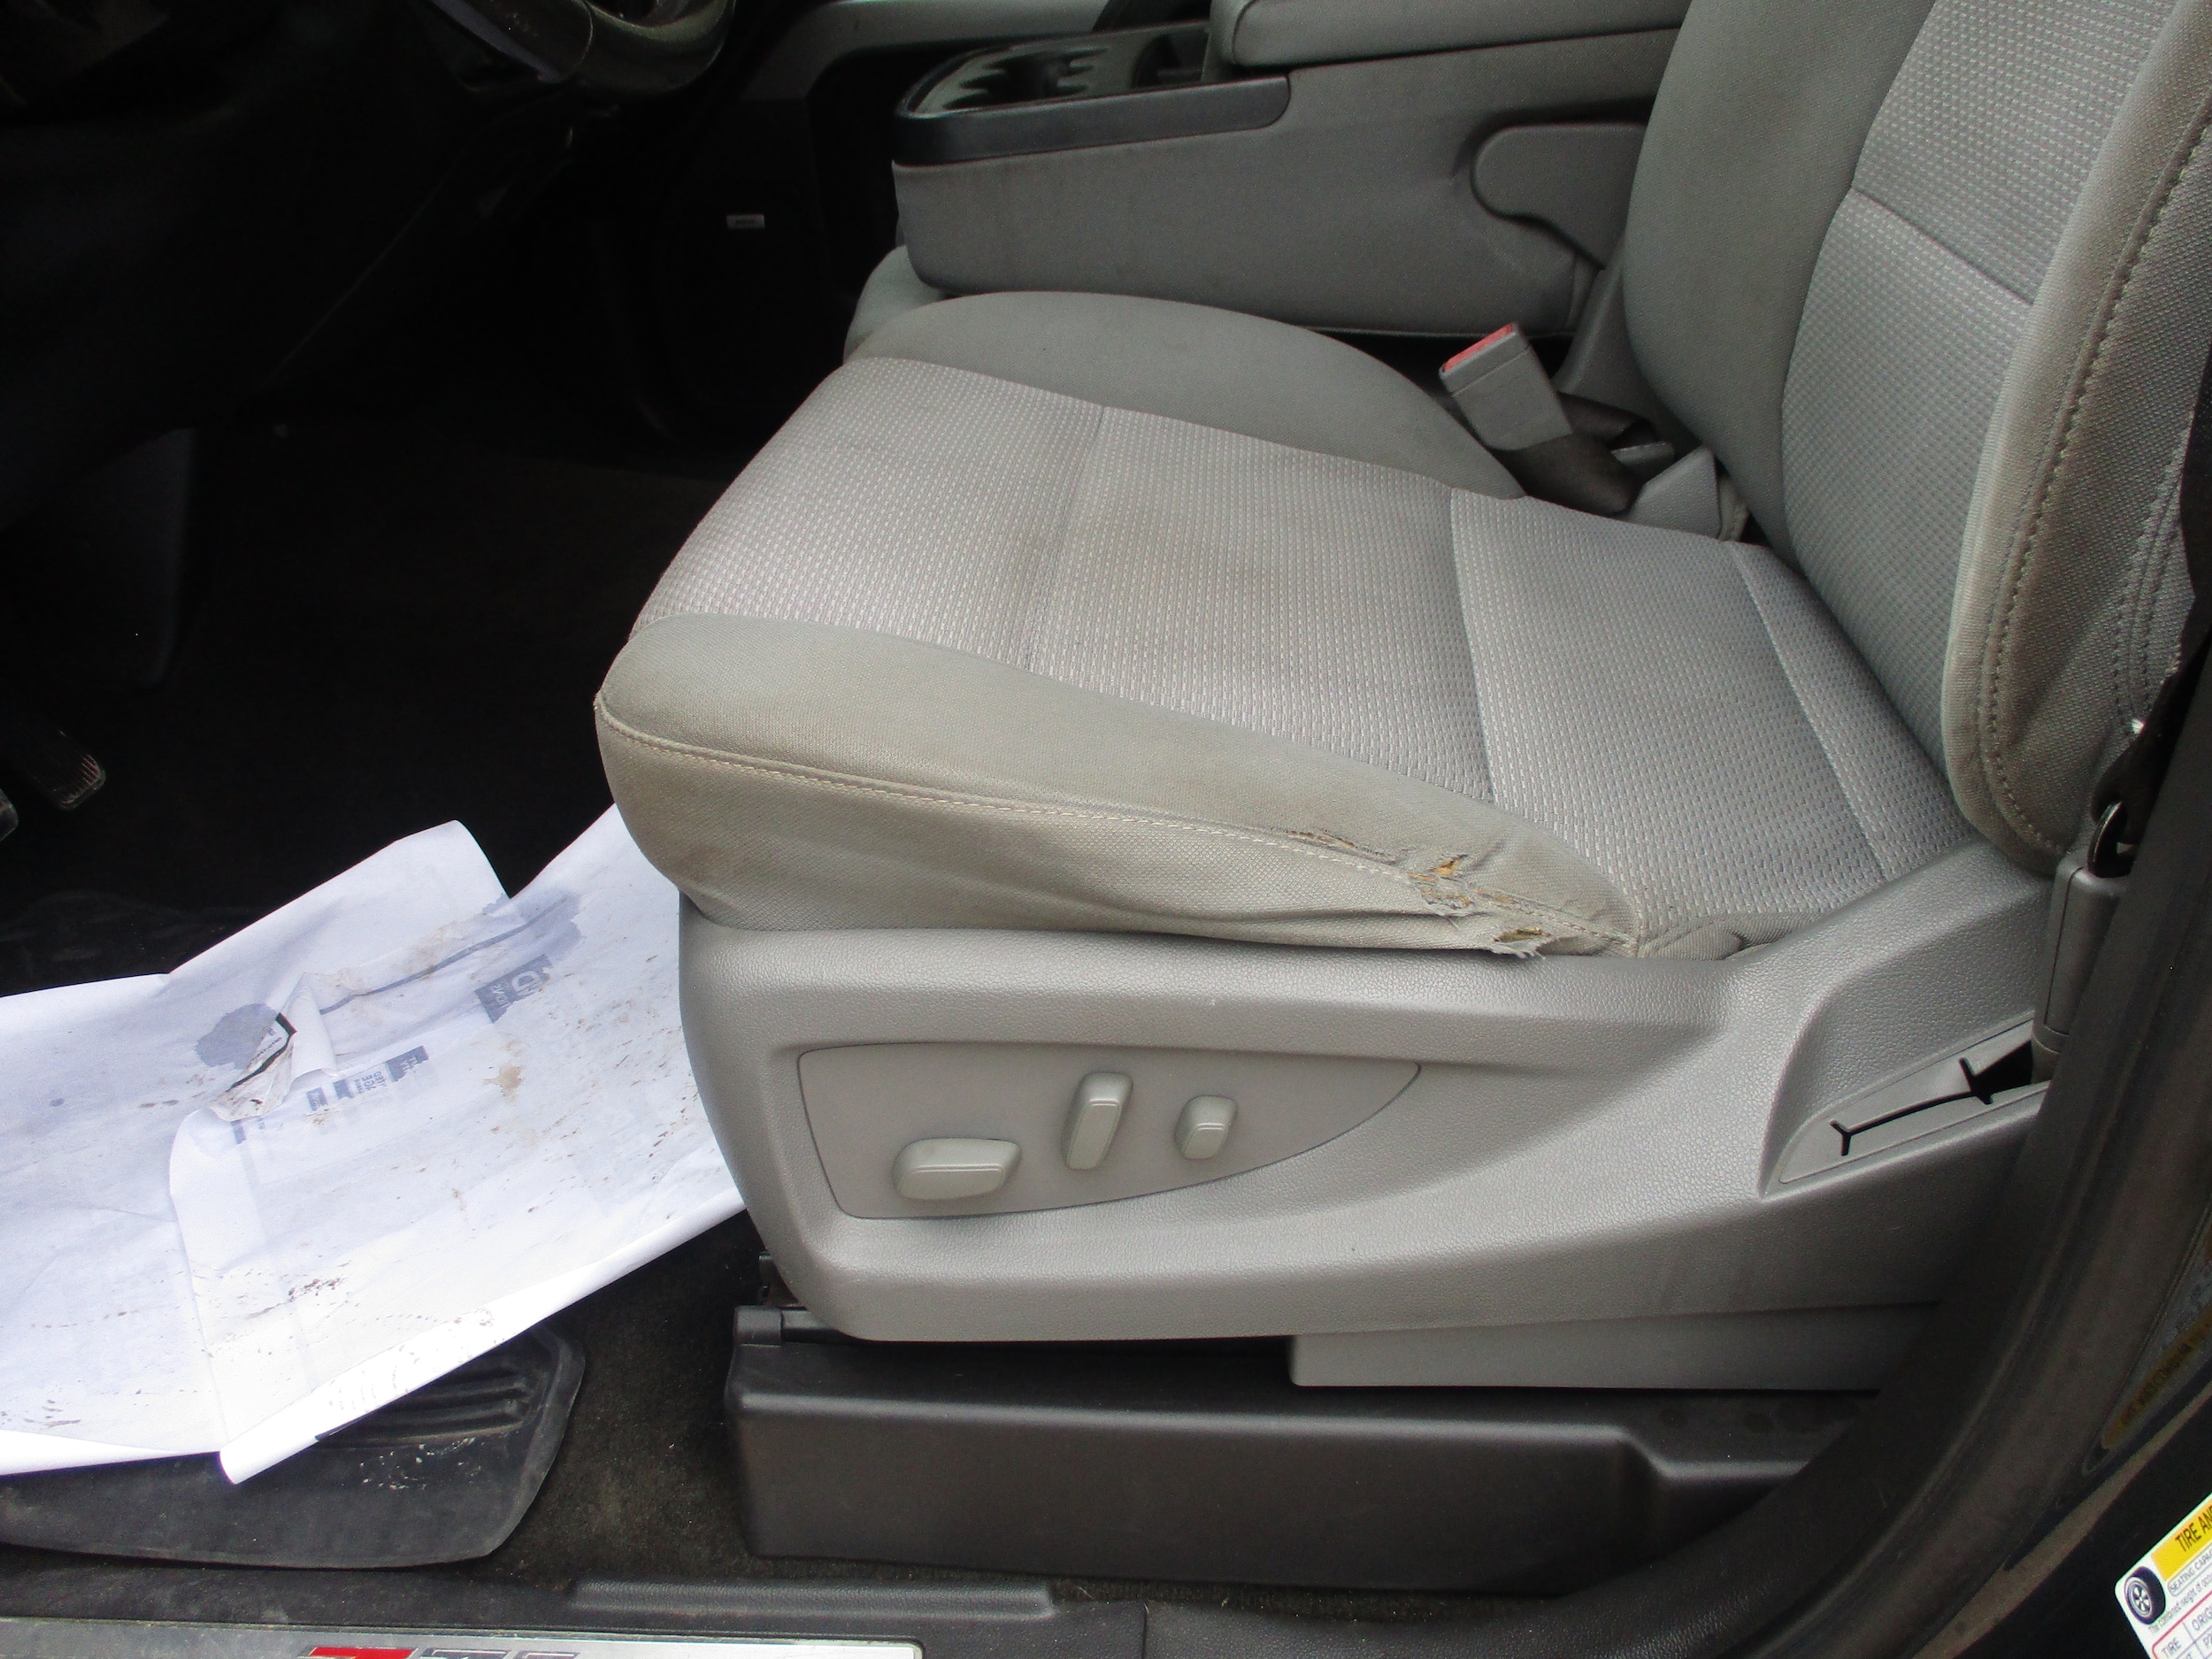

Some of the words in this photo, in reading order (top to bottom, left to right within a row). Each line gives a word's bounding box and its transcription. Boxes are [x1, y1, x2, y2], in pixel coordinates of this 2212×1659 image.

[2175, 1522, 2201, 1552] TIRE
[2169, 1567, 2196, 1593] SEATING
[2162, 1637, 2182, 1659] TIRE
